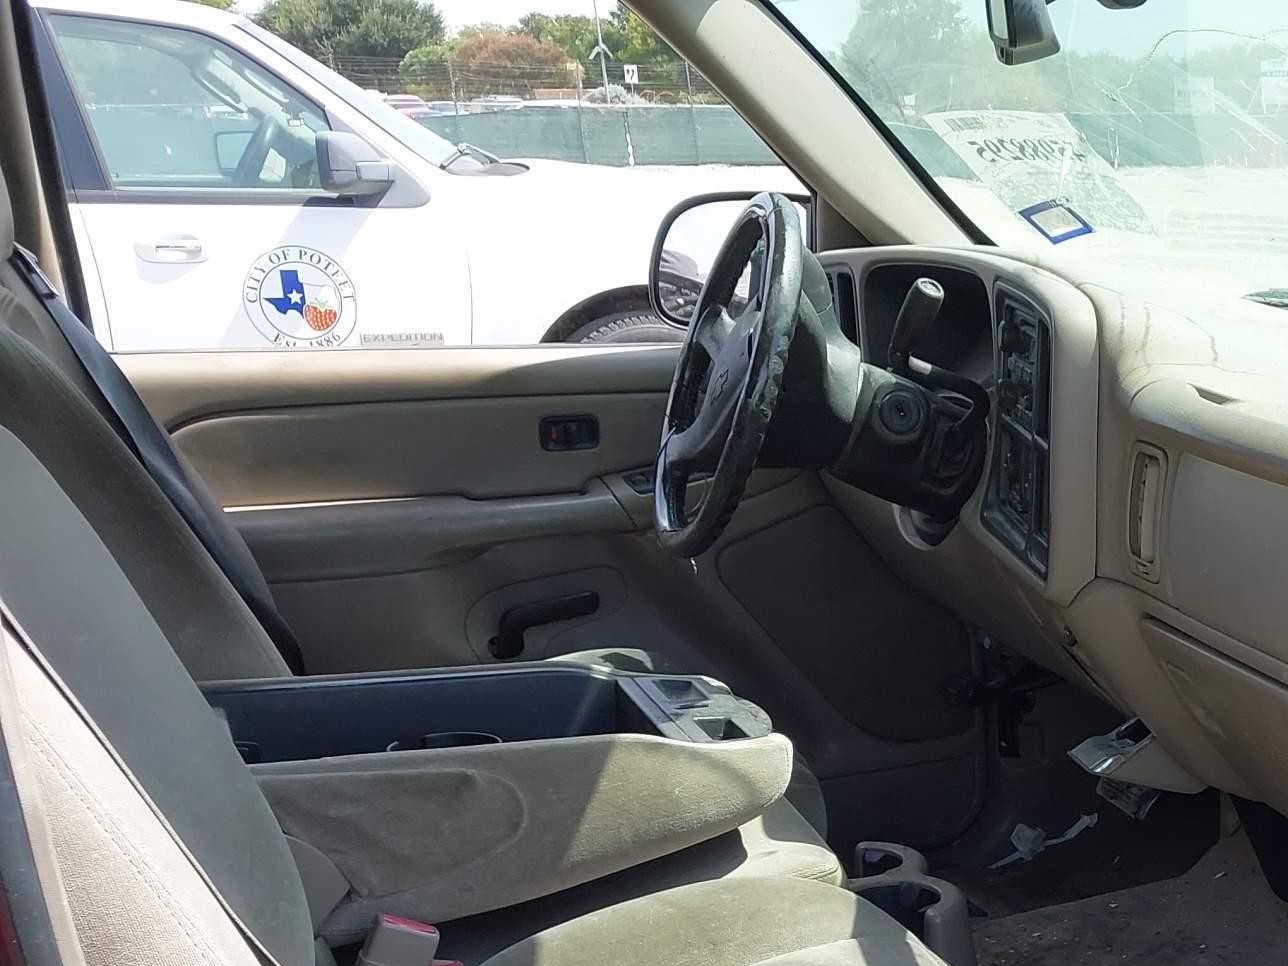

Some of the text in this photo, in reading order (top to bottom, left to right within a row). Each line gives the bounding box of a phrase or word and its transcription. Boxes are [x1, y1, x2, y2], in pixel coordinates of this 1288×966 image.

[245, 249, 355, 304] CITY OF POTEET
[362, 332, 444, 344] EXPEDITION
